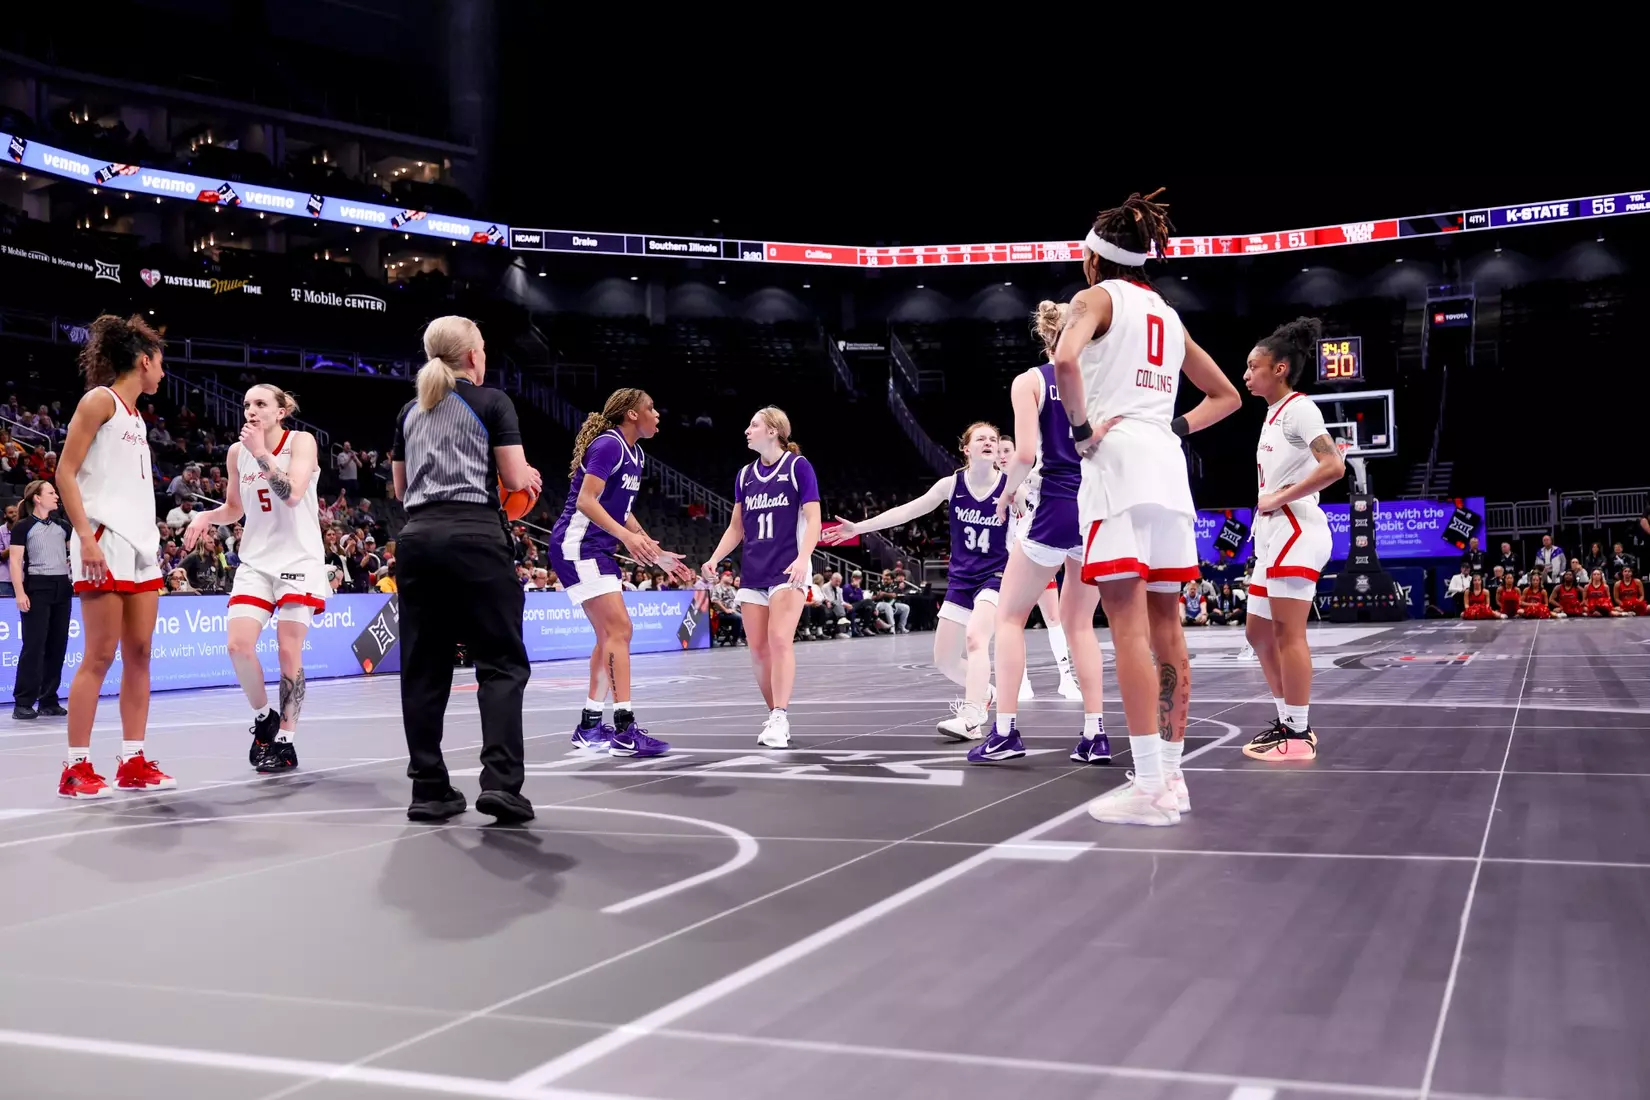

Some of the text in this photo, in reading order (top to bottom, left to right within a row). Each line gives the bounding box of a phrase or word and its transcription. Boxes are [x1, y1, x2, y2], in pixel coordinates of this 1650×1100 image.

[43, 153, 90, 176] venmo
[142, 174, 196, 194] venmo
[245, 191, 295, 209] venmo
[1591, 197, 1615, 214] 55
[340, 206, 387, 223] venmo
[1468, 214, 1486, 225] 4TH
[1505, 203, 1569, 223] K-STATE
[427, 218, 470, 236] venmo
[1340, 223, 1375, 234] TEXAS
[514, 234, 541, 244] NCAAW
[572, 236, 598, 247] Drake
[648, 240, 718, 254] Southern Illinois
[7, 246, 28, 258] Mobile
[57, 258, 76, 268] Home
[84, 263, 94, 272] the
[164, 275, 262, 295] TASTES LIKE Miller TIME
[304, 289, 342, 307] Mobile
[344, 296, 385, 311] CENTER
[1322, 342, 1350, 356] 34.8
[1327, 354, 1354, 378] 30
[257, 488, 272, 512] 5
[744, 491, 790, 511] Wildcats
[954, 506, 1003, 527] Wildcats
[1197, 517, 1216, 528] the
[1374, 510, 1393, 520] ore
[1395, 508, 1421, 519] with
[1423, 507, 1445, 518] the
[757, 511, 774, 540] 11
[1196, 528, 1212, 538] rd.
[1374, 520, 1404, 531] Debit
[1406, 519, 1440, 530] Card.
[963, 525, 991, 554] 34
[523, 608, 545, 621] core
[547, 608, 571, 620] more
[638, 602, 660, 617] Debit
[661, 602, 682, 616] Card.
[155, 611, 180, 634] he
[185, 609, 227, 633] Ven
[2, 652, 19, 667] Ea
[151, 644, 167, 658] ack
[170, 643, 195, 658] with
[196, 642, 228, 656] Venm
